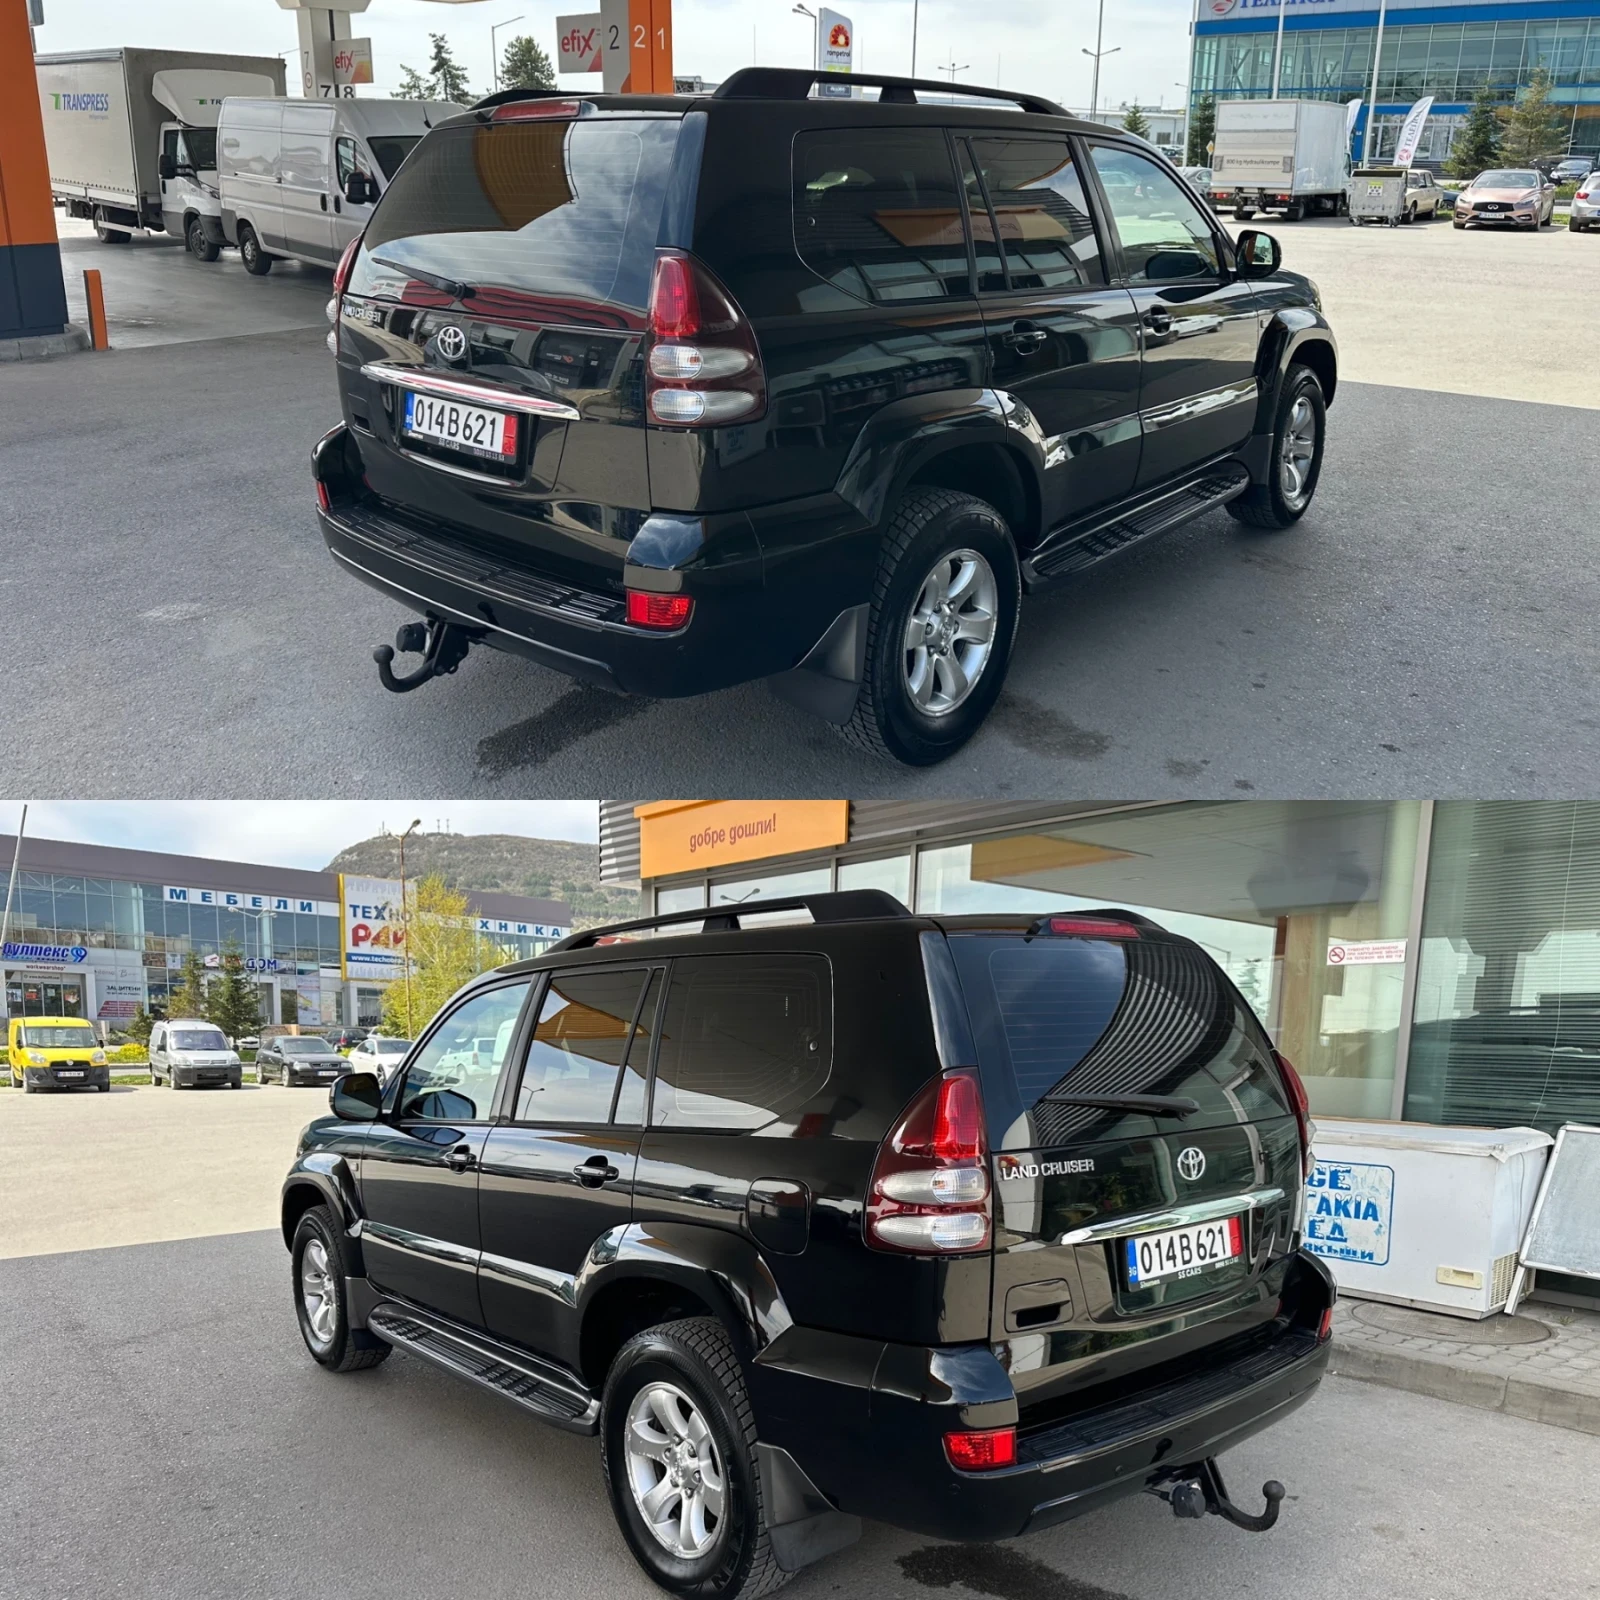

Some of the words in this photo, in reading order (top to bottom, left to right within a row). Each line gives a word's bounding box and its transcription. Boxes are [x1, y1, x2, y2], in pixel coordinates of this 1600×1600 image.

[561, 28, 595, 58] efix
[608, 24, 620, 50] 2
[633, 24, 646, 48] 2
[656, 27, 665, 50] 1
[334, 50, 354, 73] efix
[826, 50, 851, 59] rompetrol
[62, 93, 109, 111] TRANSPRESS
[320, 84, 332, 98] 7
[343, 85, 355, 99] 8
[689, 826, 726, 853] добре
[729, 812, 776, 846] дошли!
[1002, 1164, 1039, 1180] LAND
[1040, 1158, 1095, 1176] CRUISER
[1177, 1270, 1186, 1279] SS
[1186, 1266, 1202, 1277] CARS
